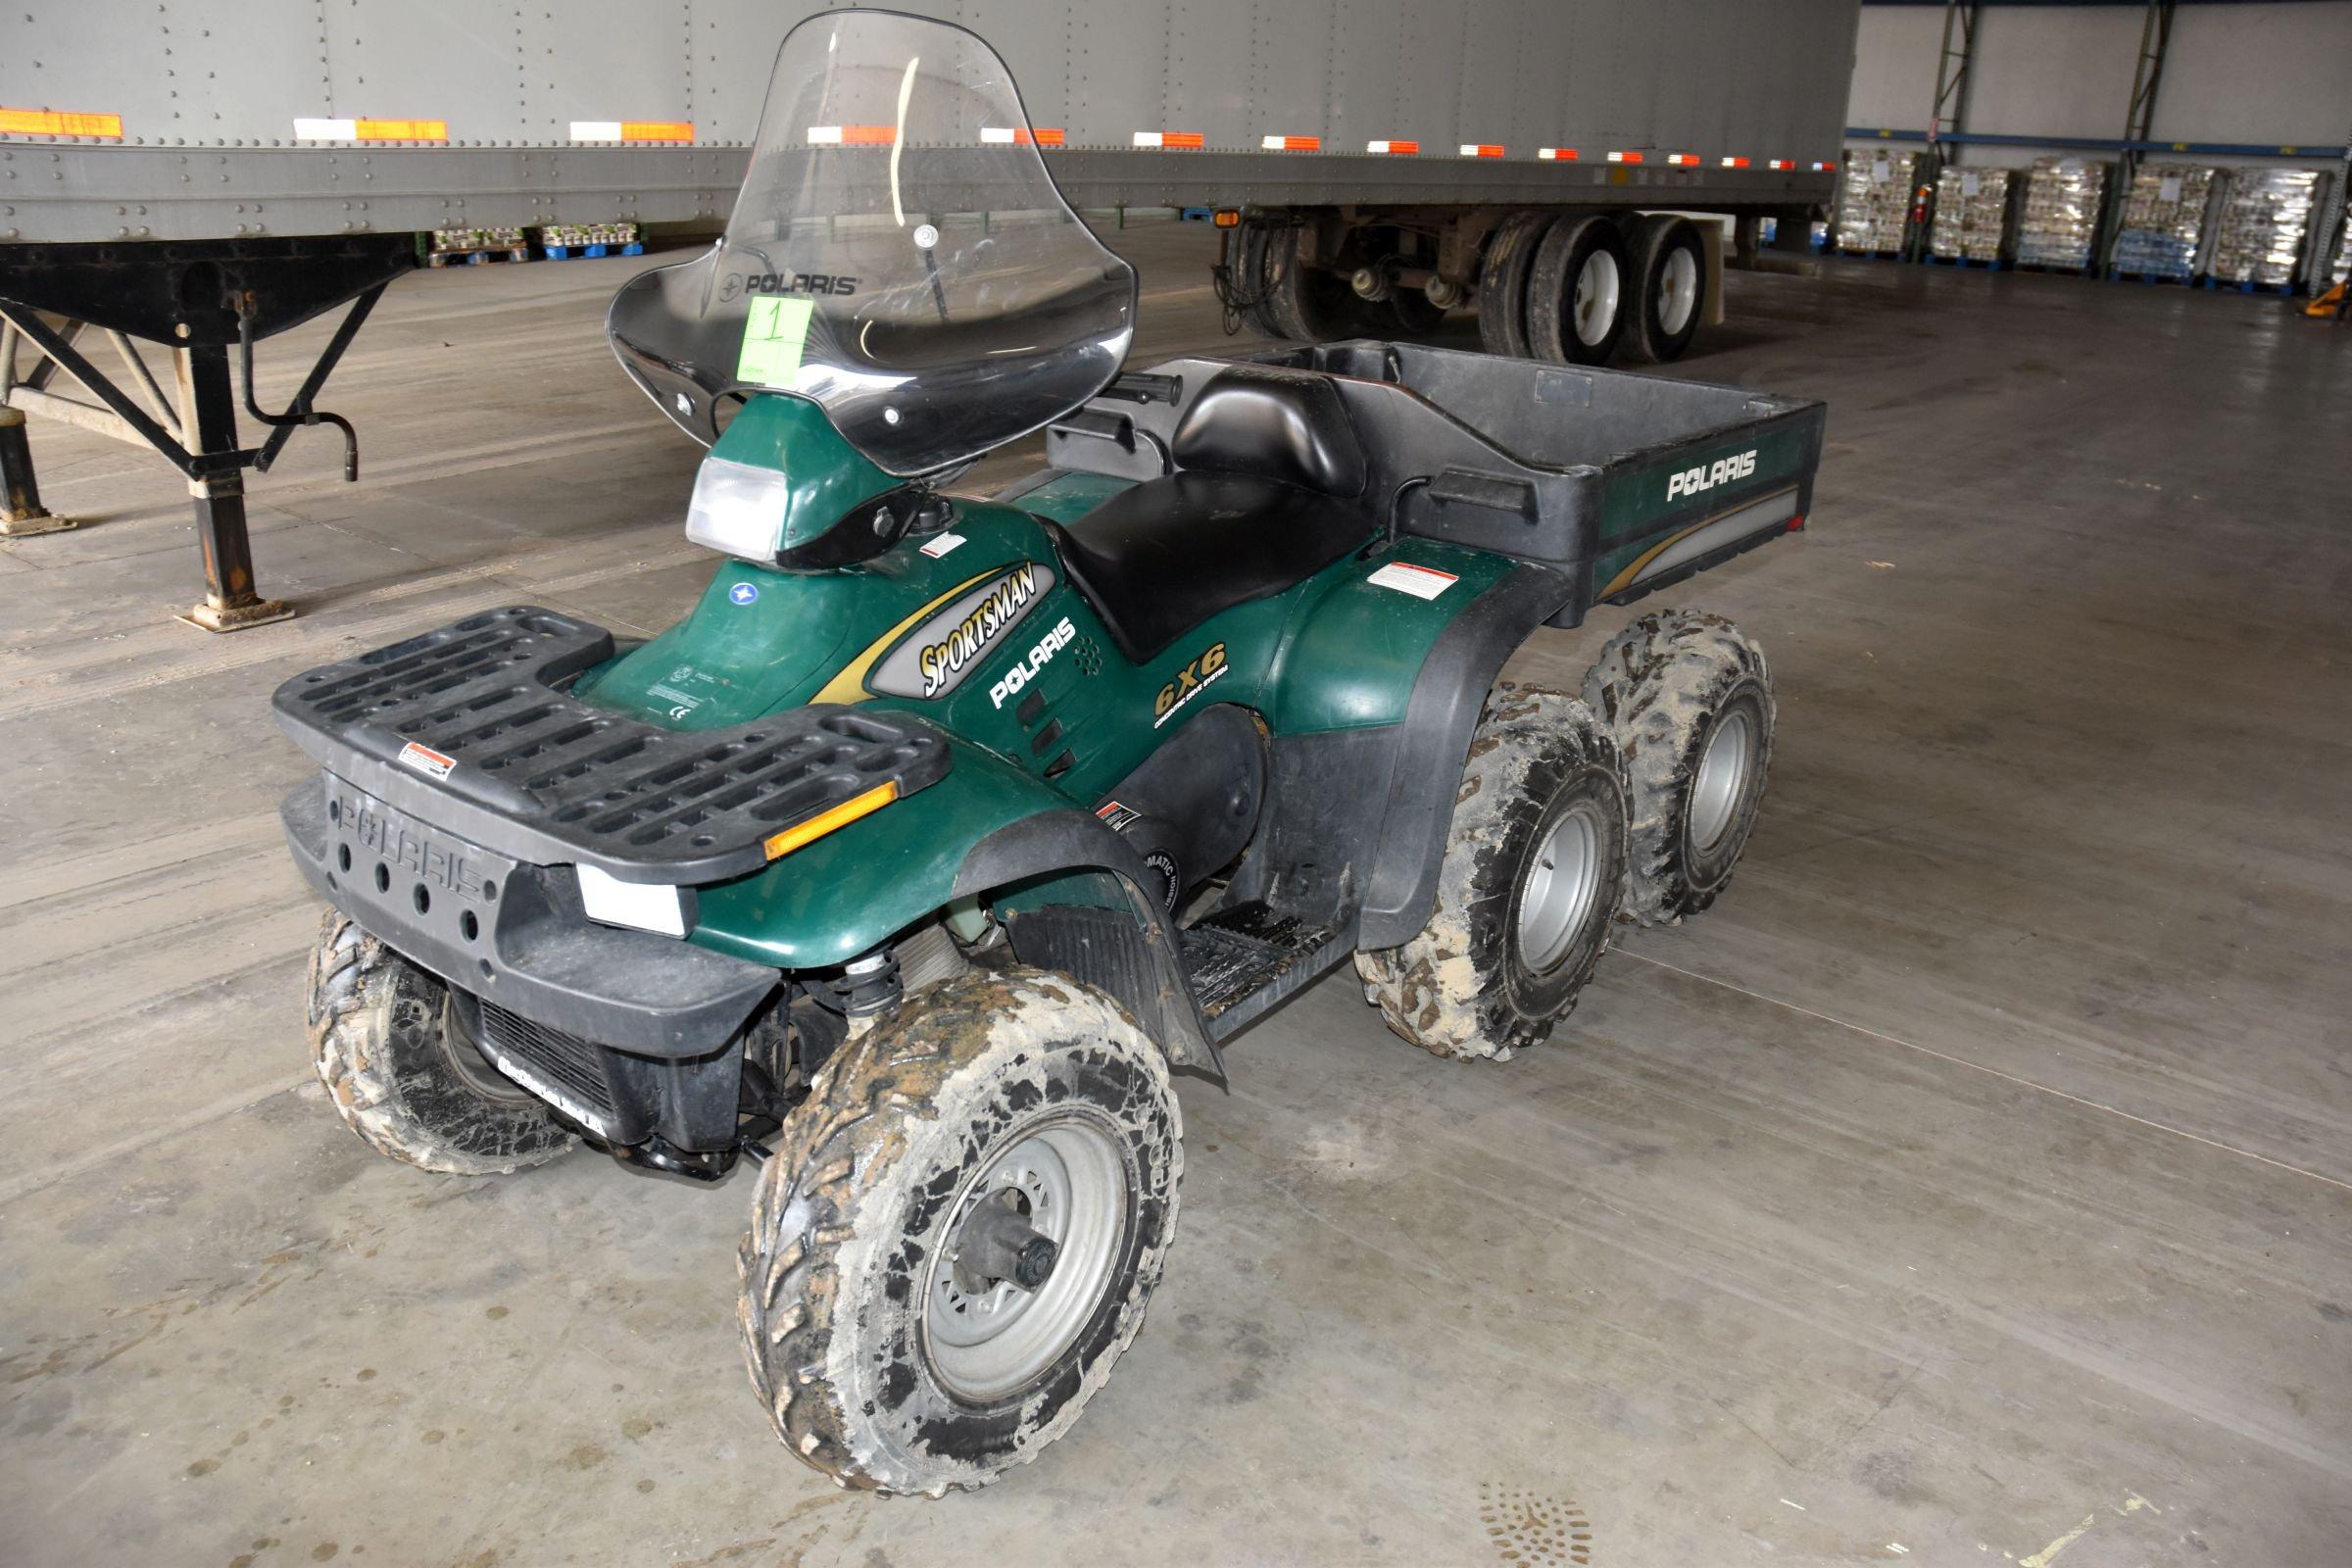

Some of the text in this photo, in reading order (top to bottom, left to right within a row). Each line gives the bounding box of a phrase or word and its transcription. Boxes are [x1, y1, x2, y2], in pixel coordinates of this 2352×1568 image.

[745, 273, 858, 295] POLARIS
[764, 300, 784, 340] 1
[1667, 450, 1757, 502] POLARIS
[920, 561, 1036, 698] SPORTSMAN
[989, 616, 1076, 710] POLARIS
[1186, 683, 1203, 702] DRIVE
[1202, 664, 1229, 687] SYSTEM
[339, 796, 479, 904] POLARIS
[1145, 855, 1174, 876] MATIC
